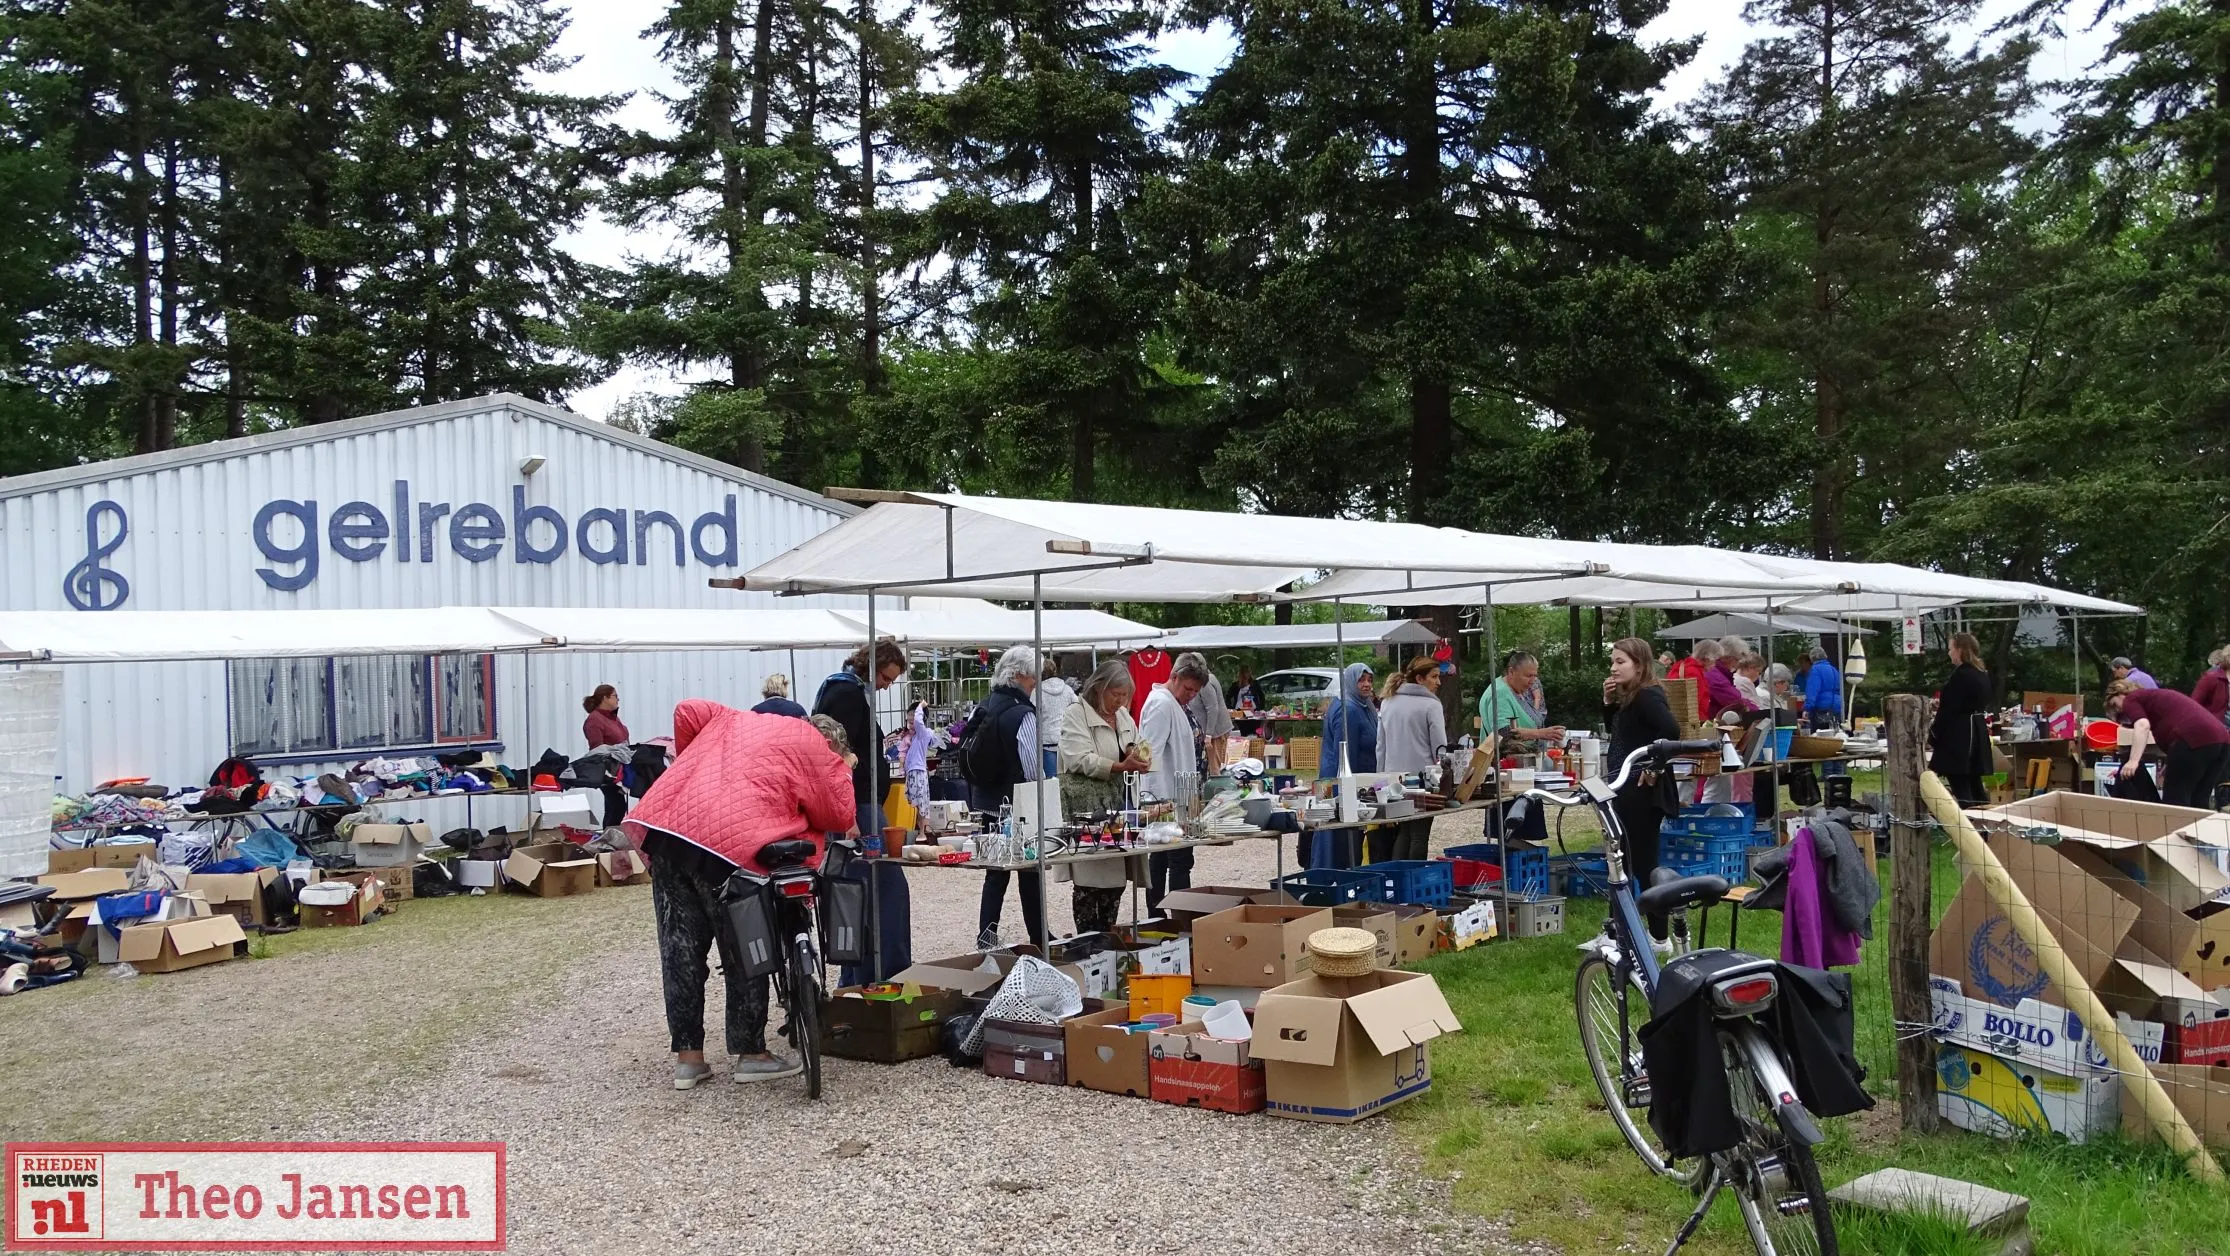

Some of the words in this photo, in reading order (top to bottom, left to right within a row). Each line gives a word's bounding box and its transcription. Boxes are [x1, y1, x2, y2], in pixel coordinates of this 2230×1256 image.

[253, 479, 738, 592] gelreband
[1984, 1013, 2054, 1047] BOLLO
[1277, 1102, 1310, 1114] IKEA
[1358, 1100, 1379, 1114] IKEA
